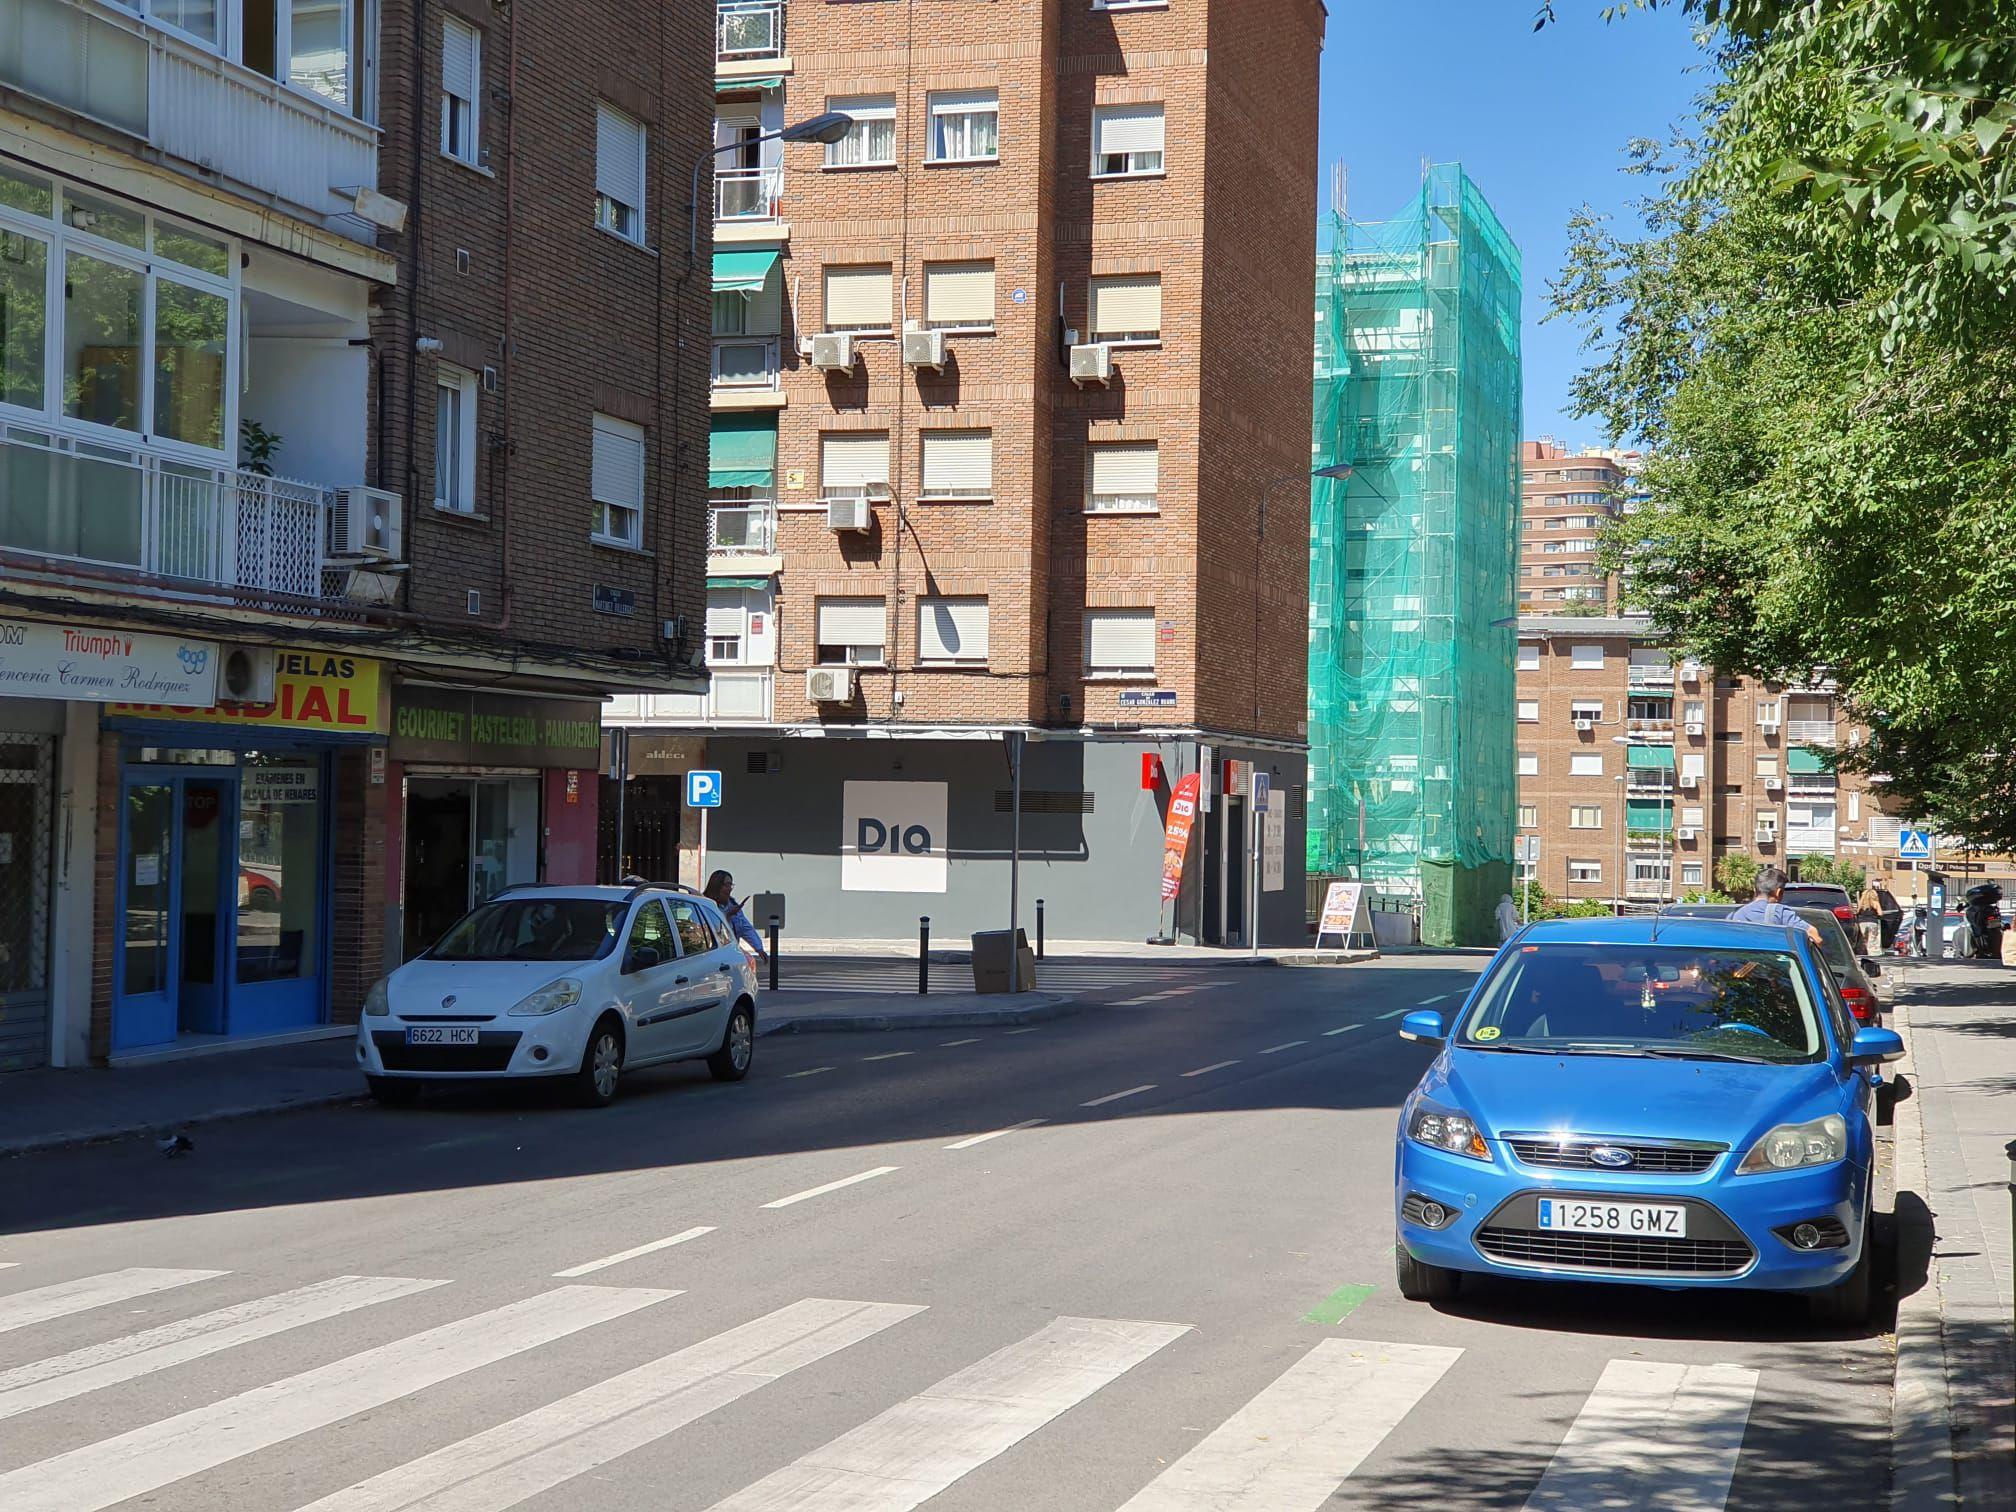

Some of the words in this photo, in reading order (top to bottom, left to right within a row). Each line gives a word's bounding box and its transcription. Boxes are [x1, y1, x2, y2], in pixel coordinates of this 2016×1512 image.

[63, 629, 121, 660] Triumph
[0, 657, 50, 684] enceria
[57, 660, 115, 688] Carmen
[115, 683, 367, 725] DIAL
[397, 706, 465, 742] GOURMET
[295, 773, 305, 785] EN
[692, 775, 713, 803] P
[273, 789, 282, 801] DE
[284, 788, 317, 801] HENARES
[858, 818, 931, 854] Dia
[412, 1029, 443, 1042] 6622
[450, 1029, 474, 1042] HCK
[1559, 1204, 1620, 1230] 1258
[1630, 1208, 1679, 1233] GMZ
